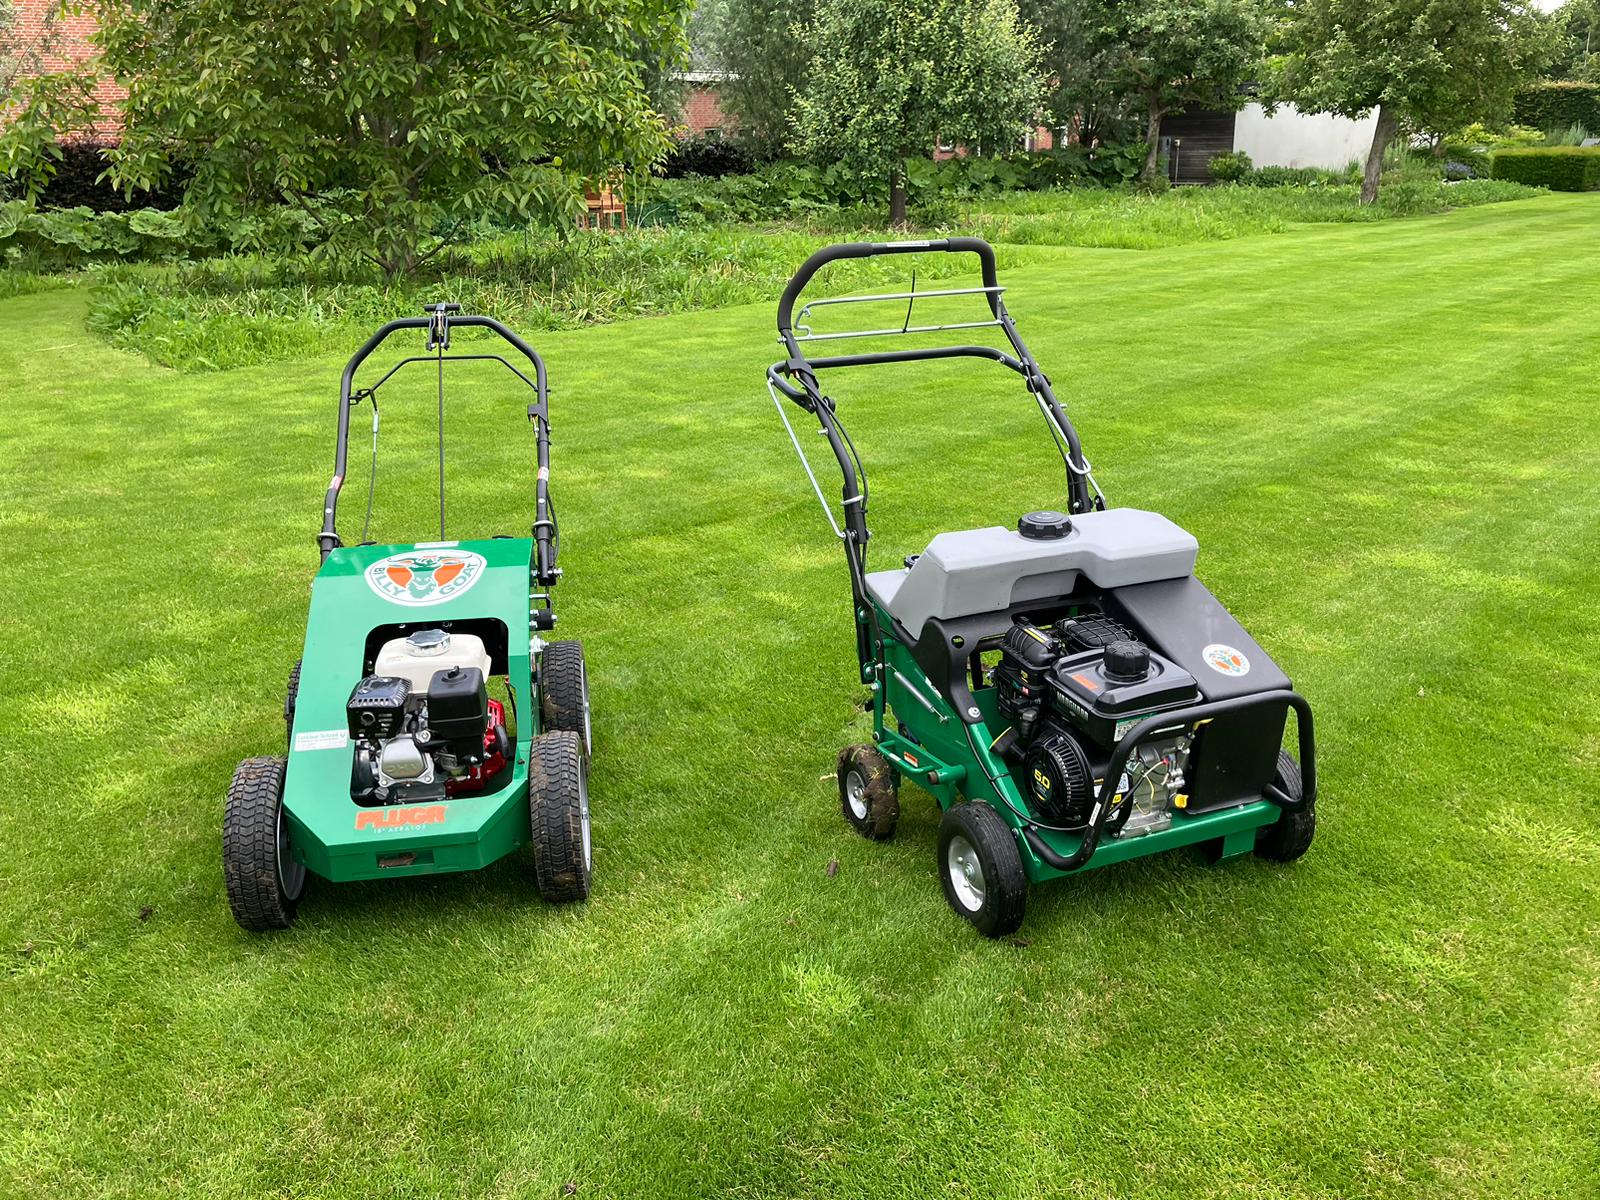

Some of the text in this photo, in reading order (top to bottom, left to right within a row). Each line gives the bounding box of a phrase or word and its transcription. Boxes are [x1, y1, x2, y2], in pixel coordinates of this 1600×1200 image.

[374, 562, 477, 596] BILLY GOAT
[355, 806, 447, 830] PLUGR
